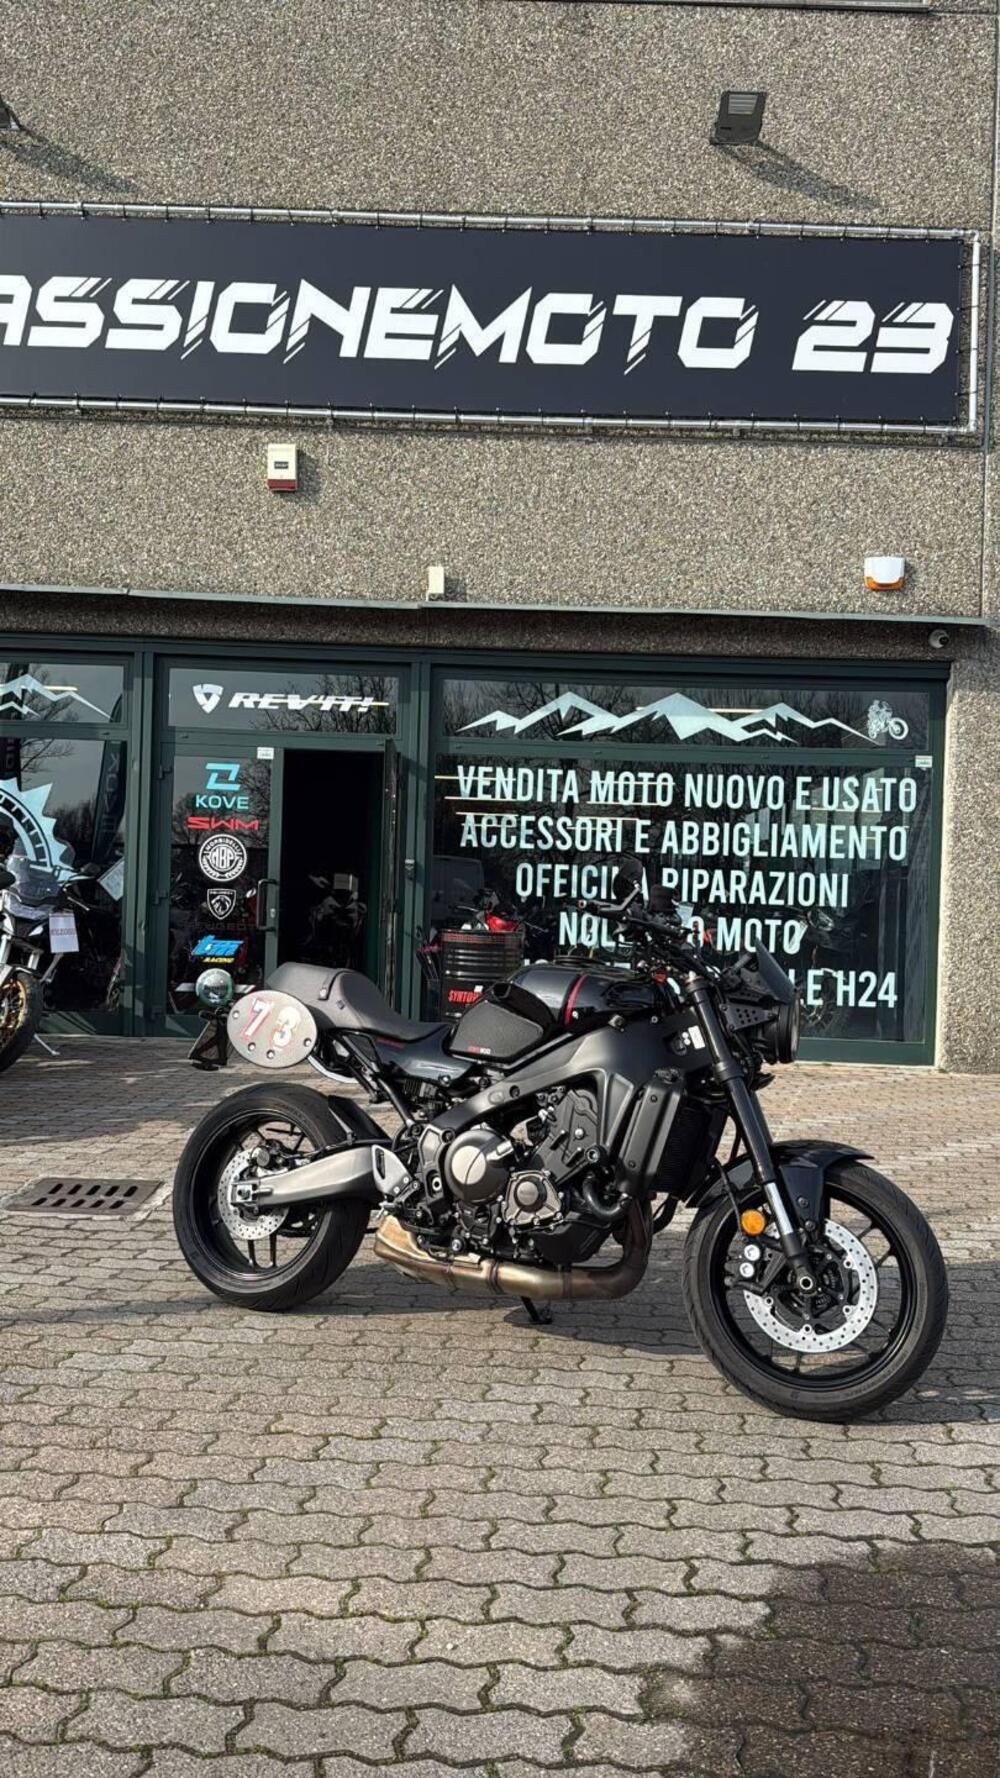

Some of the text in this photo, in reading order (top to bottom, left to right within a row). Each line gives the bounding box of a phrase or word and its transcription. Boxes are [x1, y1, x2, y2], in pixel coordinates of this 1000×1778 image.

[792, 300, 954, 374] 23
[195, 794, 249, 810] KOVE
[457, 765, 917, 813] VENDITA MOTO NUOVO E USATO
[460, 813, 907, 861] ACCESSORI E ABBIGLIAMENTO
[516, 862, 650, 901] OFFICI
[716, 917, 801, 955] MOTO
[836, 970, 898, 1008] H24
